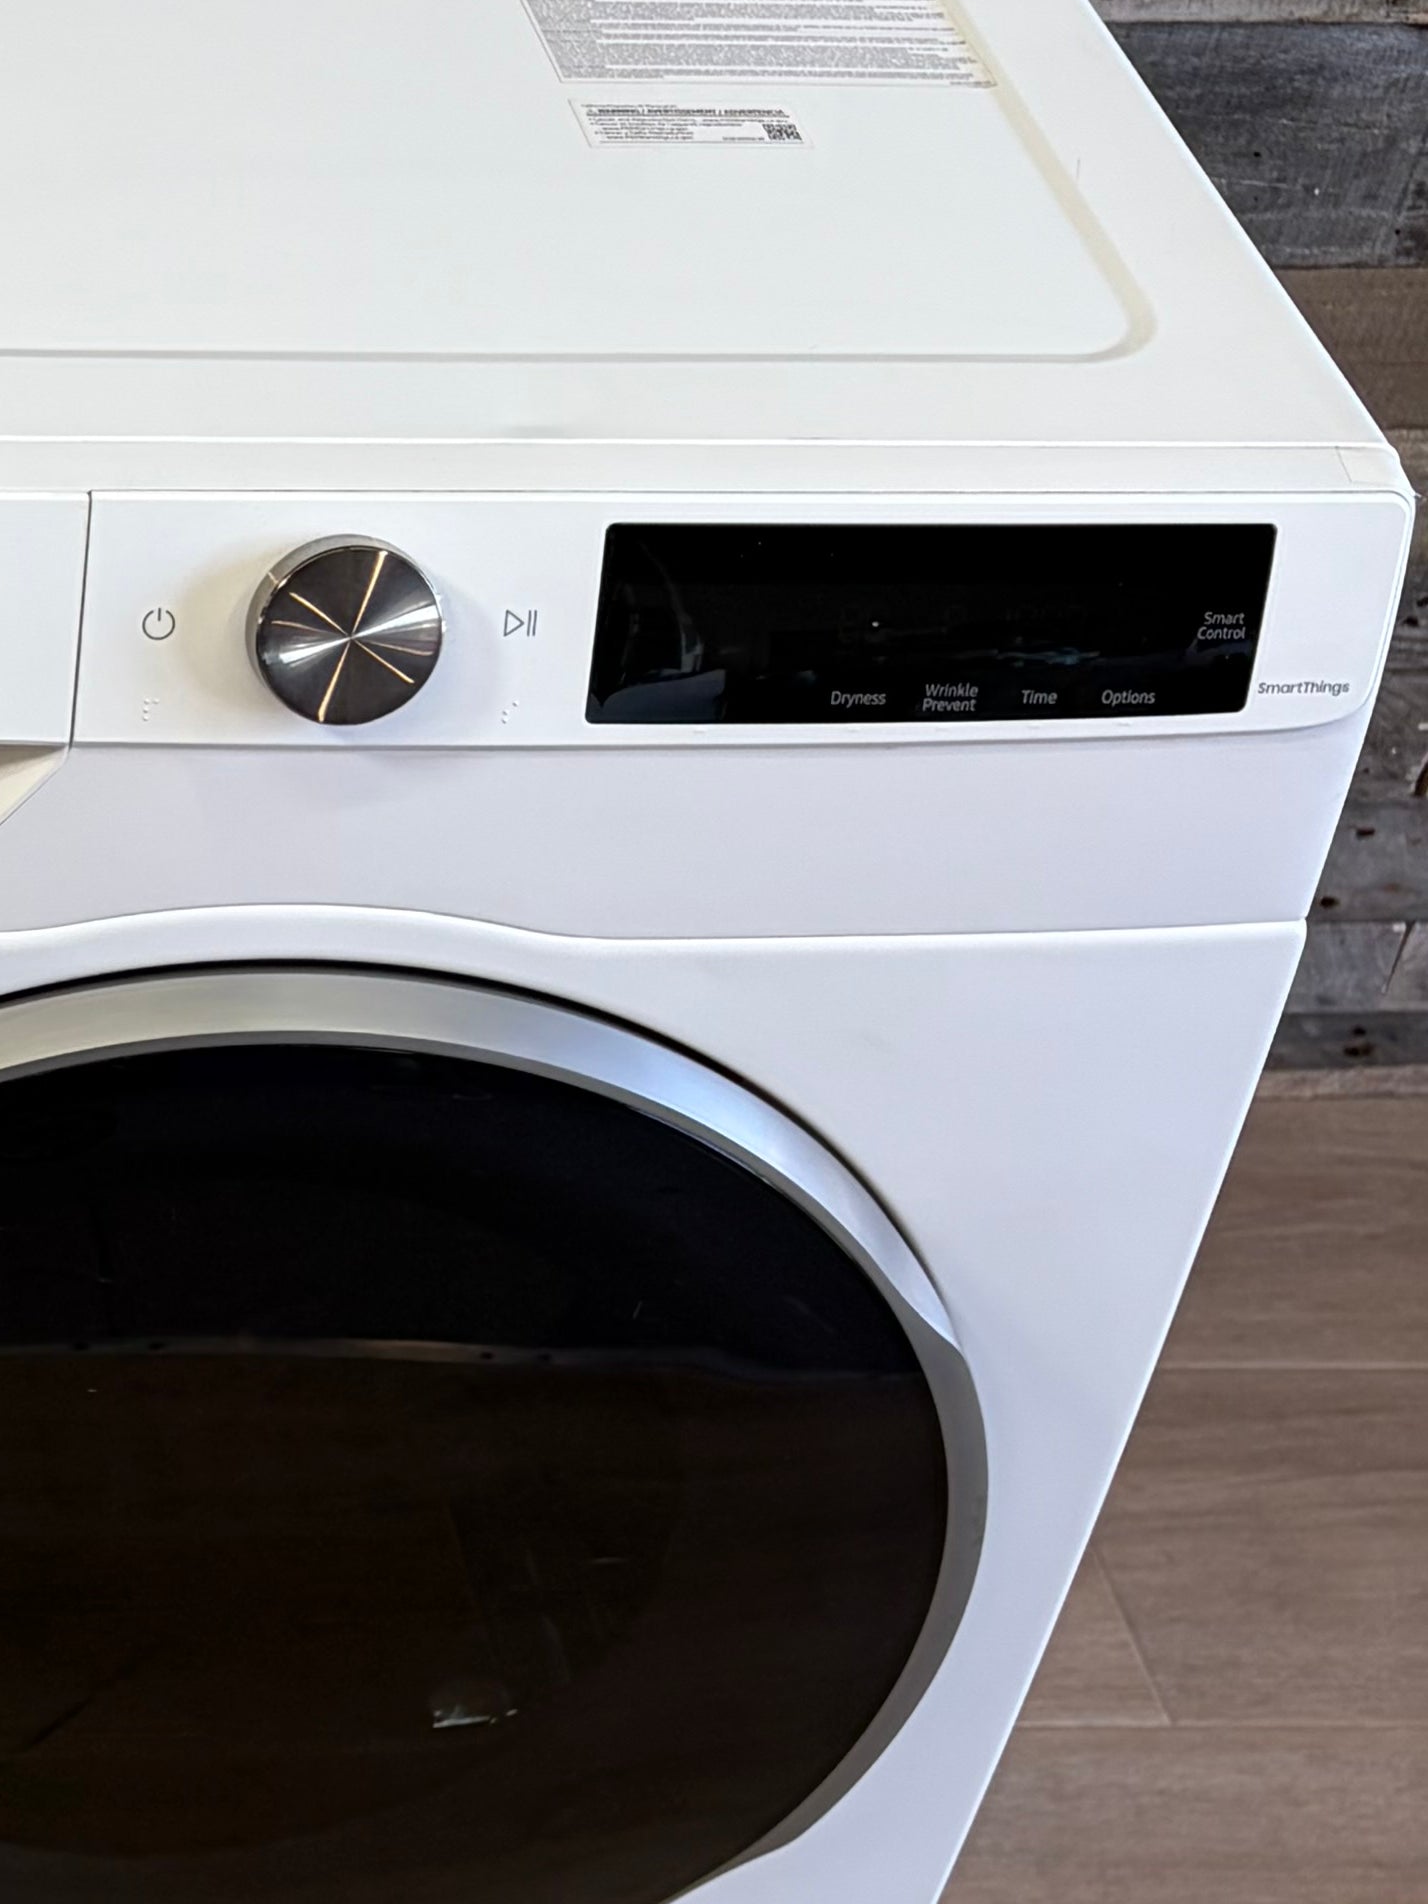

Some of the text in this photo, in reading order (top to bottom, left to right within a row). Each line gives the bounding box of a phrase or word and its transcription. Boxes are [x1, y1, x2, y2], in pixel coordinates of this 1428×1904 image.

[1204, 611, 1245, 625] Smart
[1197, 626, 1246, 640] Control
[925, 682, 979, 698] Wrinkle
[1257, 680, 1351, 696] SmartThings
[830, 690, 887, 709] Dryness
[922, 698, 977, 712] Prevent
[1021, 689, 1058, 705] Time
[1101, 689, 1156, 706] Options
